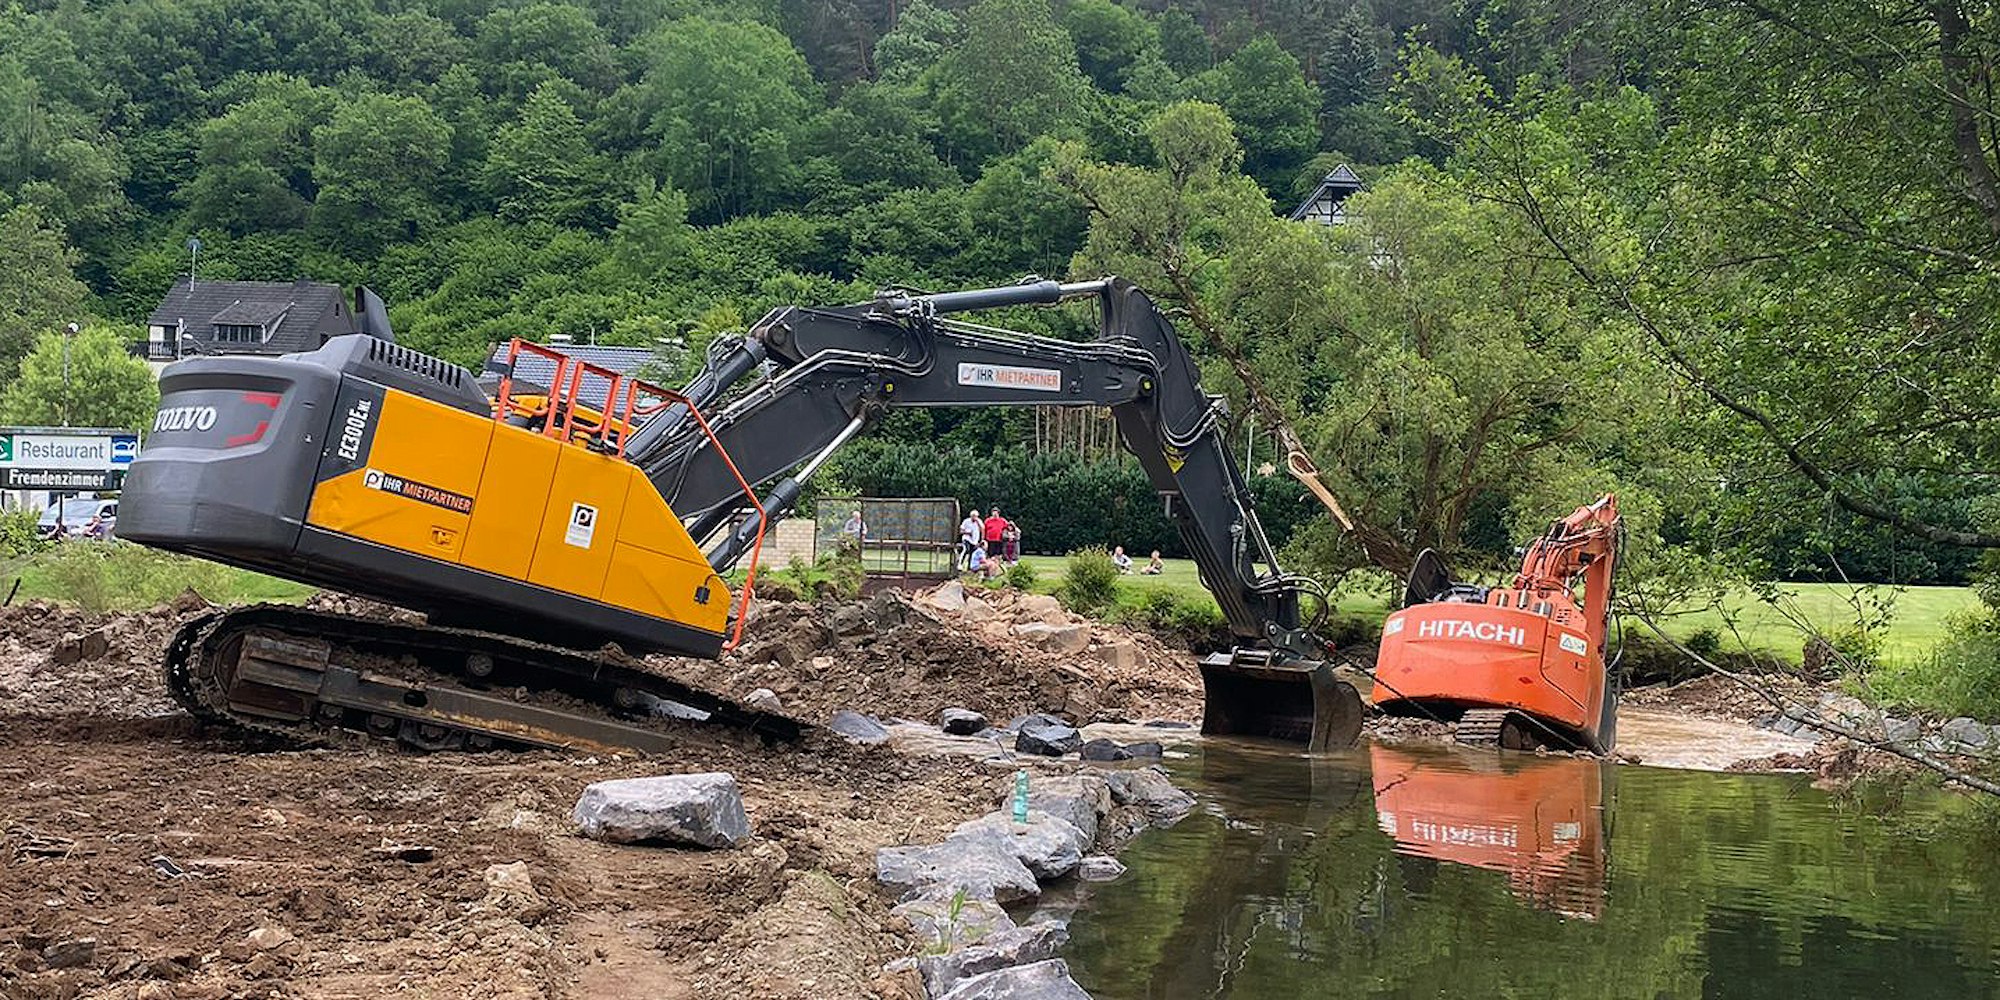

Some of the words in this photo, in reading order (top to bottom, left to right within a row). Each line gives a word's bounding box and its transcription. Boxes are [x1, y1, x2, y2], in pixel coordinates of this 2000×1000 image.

[977, 367, 994, 381] IHR
[996, 370, 1058, 388] MIETPARTNER
[153, 406, 217, 432] VOLVO
[21, 441, 104, 459] Restaurant
[9, 468, 105, 486] Fremdenzimmer
[383, 476, 403, 492] IHR
[403, 482, 472, 512] MIETPARTNER
[1418, 620, 1525, 646] HITACHI
